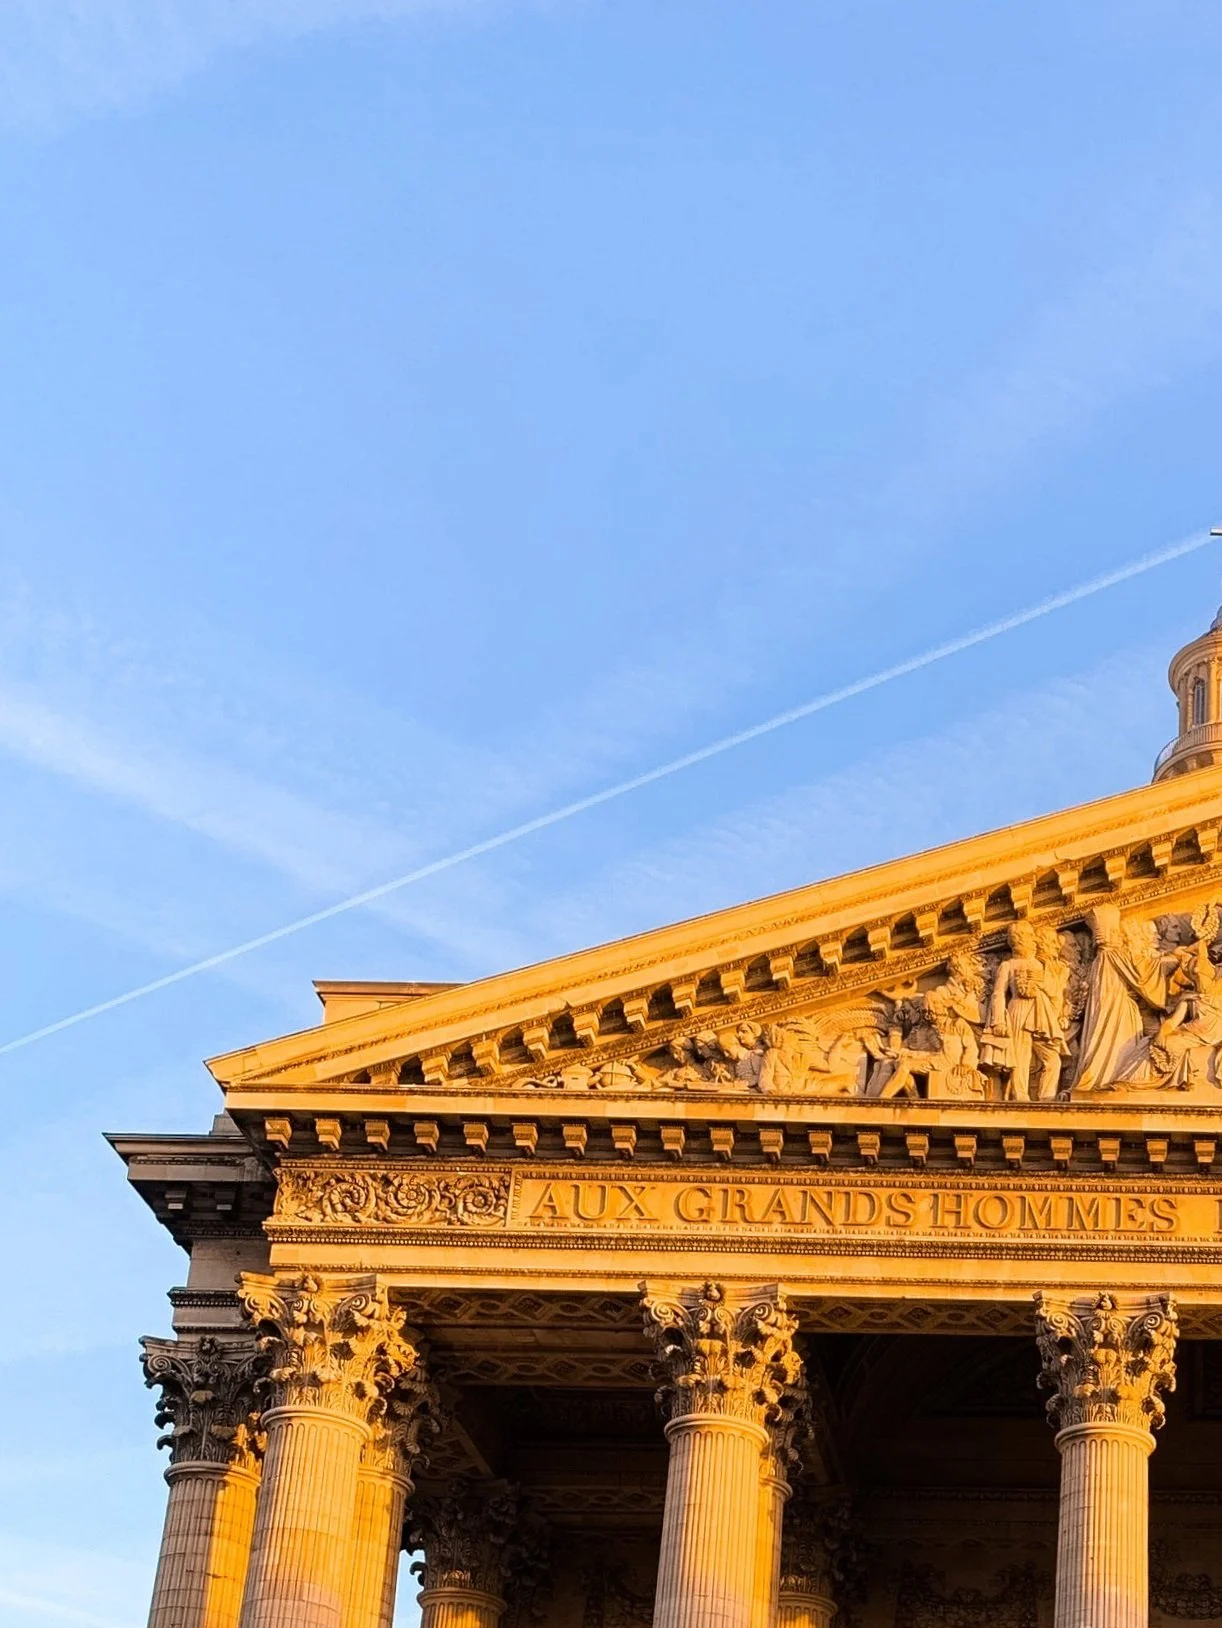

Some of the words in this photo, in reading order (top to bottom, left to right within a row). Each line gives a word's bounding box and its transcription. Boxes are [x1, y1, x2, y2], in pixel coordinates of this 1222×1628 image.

[523, 1182, 660, 1221] AUX
[673, 1184, 917, 1228] GRANDS
[928, 1192, 1179, 1232] HOMMES
